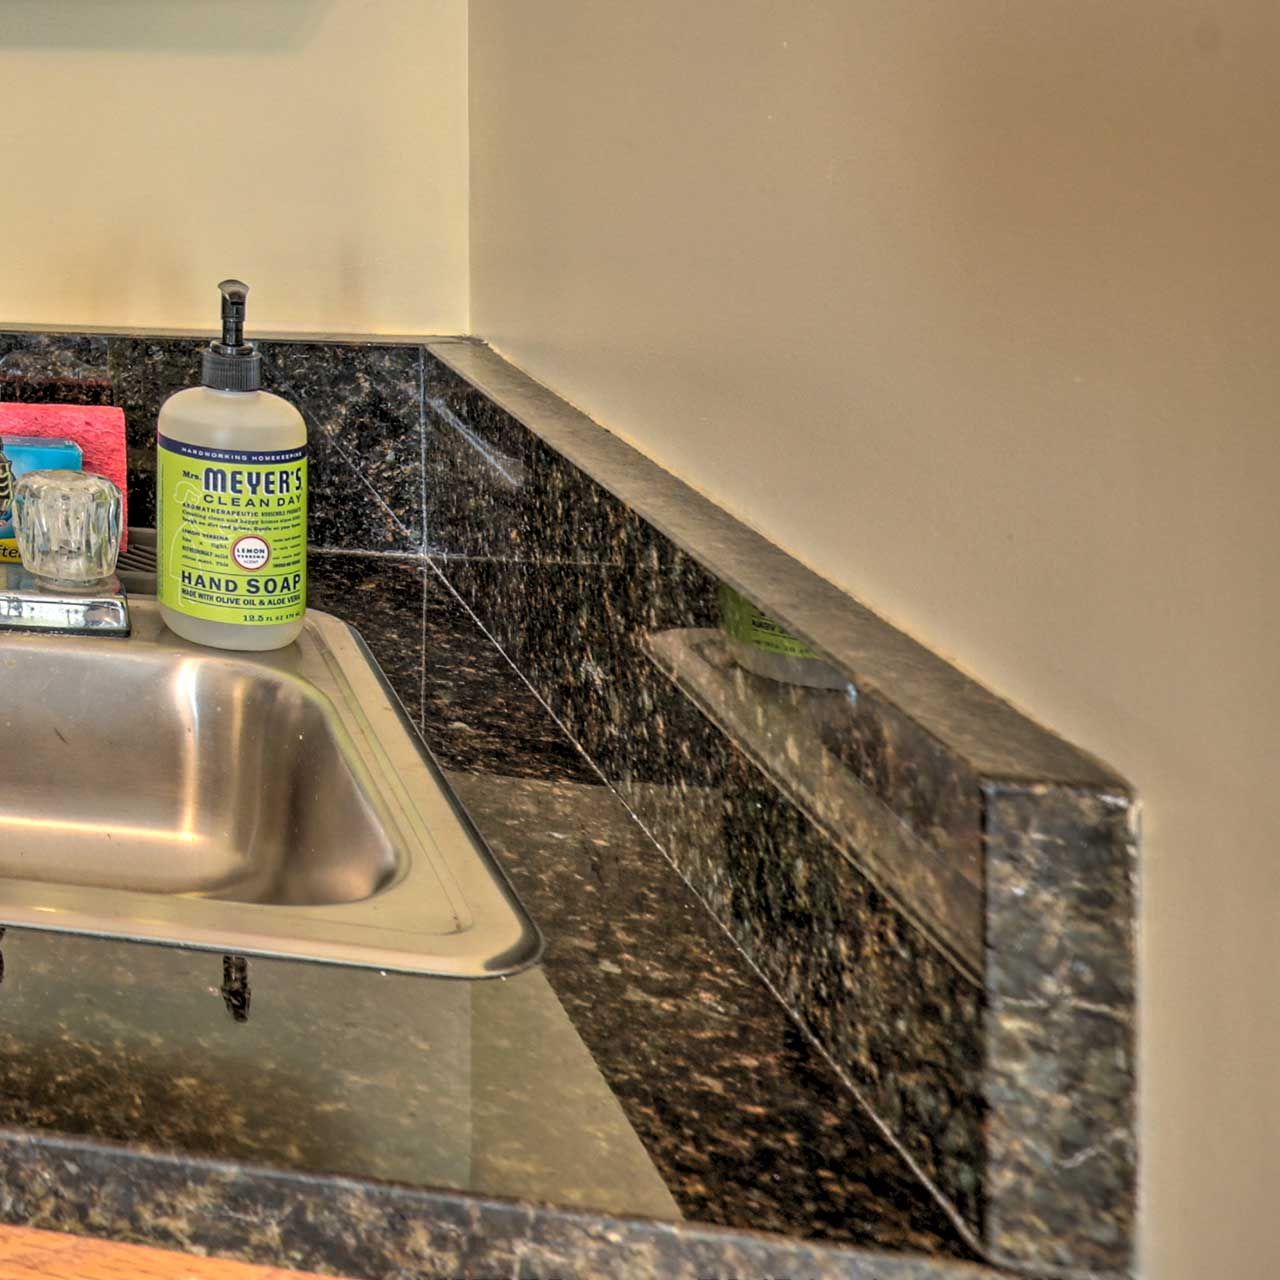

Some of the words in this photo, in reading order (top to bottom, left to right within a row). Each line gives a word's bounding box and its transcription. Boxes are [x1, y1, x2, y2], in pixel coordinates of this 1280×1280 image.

[181, 447, 247, 461] HARDWORKING
[182, 470, 202, 481] Mrs.
[203, 466, 302, 496] MEYER'S
[203, 494, 270, 508] CLEAN
[277, 494, 302, 507] DAY
[181, 570, 238, 593] HAND
[246, 573, 301, 594] SOAP
[198, 592, 214, 601] WITH
[215, 595, 240, 606] OLIVE
[242, 598, 257, 607] OIL
[266, 597, 286, 606] ALOE
[243, 614, 264, 622] 12.5
